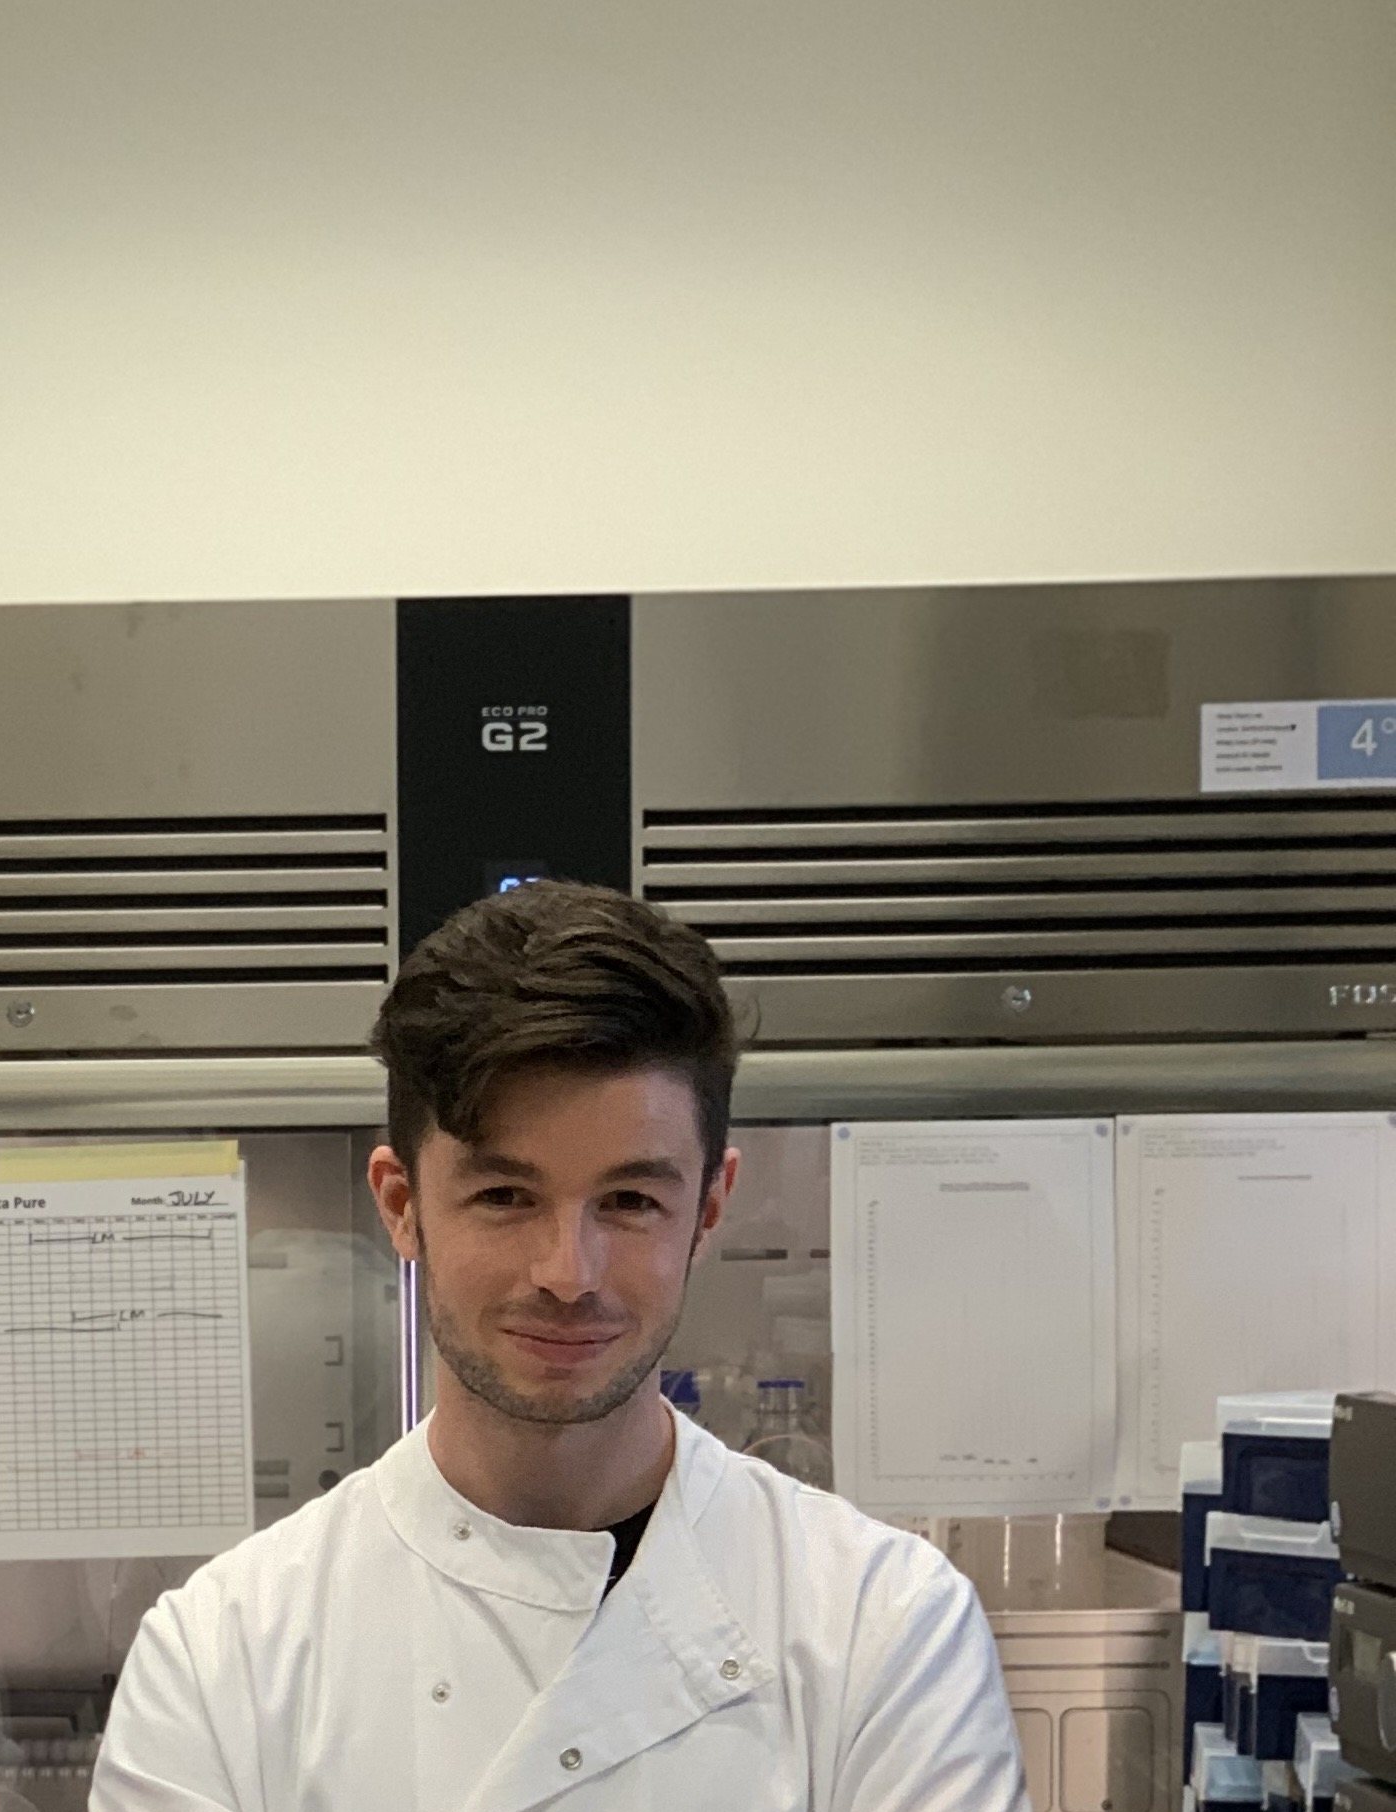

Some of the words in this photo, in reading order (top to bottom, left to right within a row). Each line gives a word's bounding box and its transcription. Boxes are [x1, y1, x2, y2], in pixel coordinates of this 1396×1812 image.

[481, 706, 513, 717] ECO
[518, 706, 548, 716] PRO
[482, 721, 548, 751] G2
[14, 1197, 46, 1209] Pure
[168, 1191, 215, 1207] JULY
